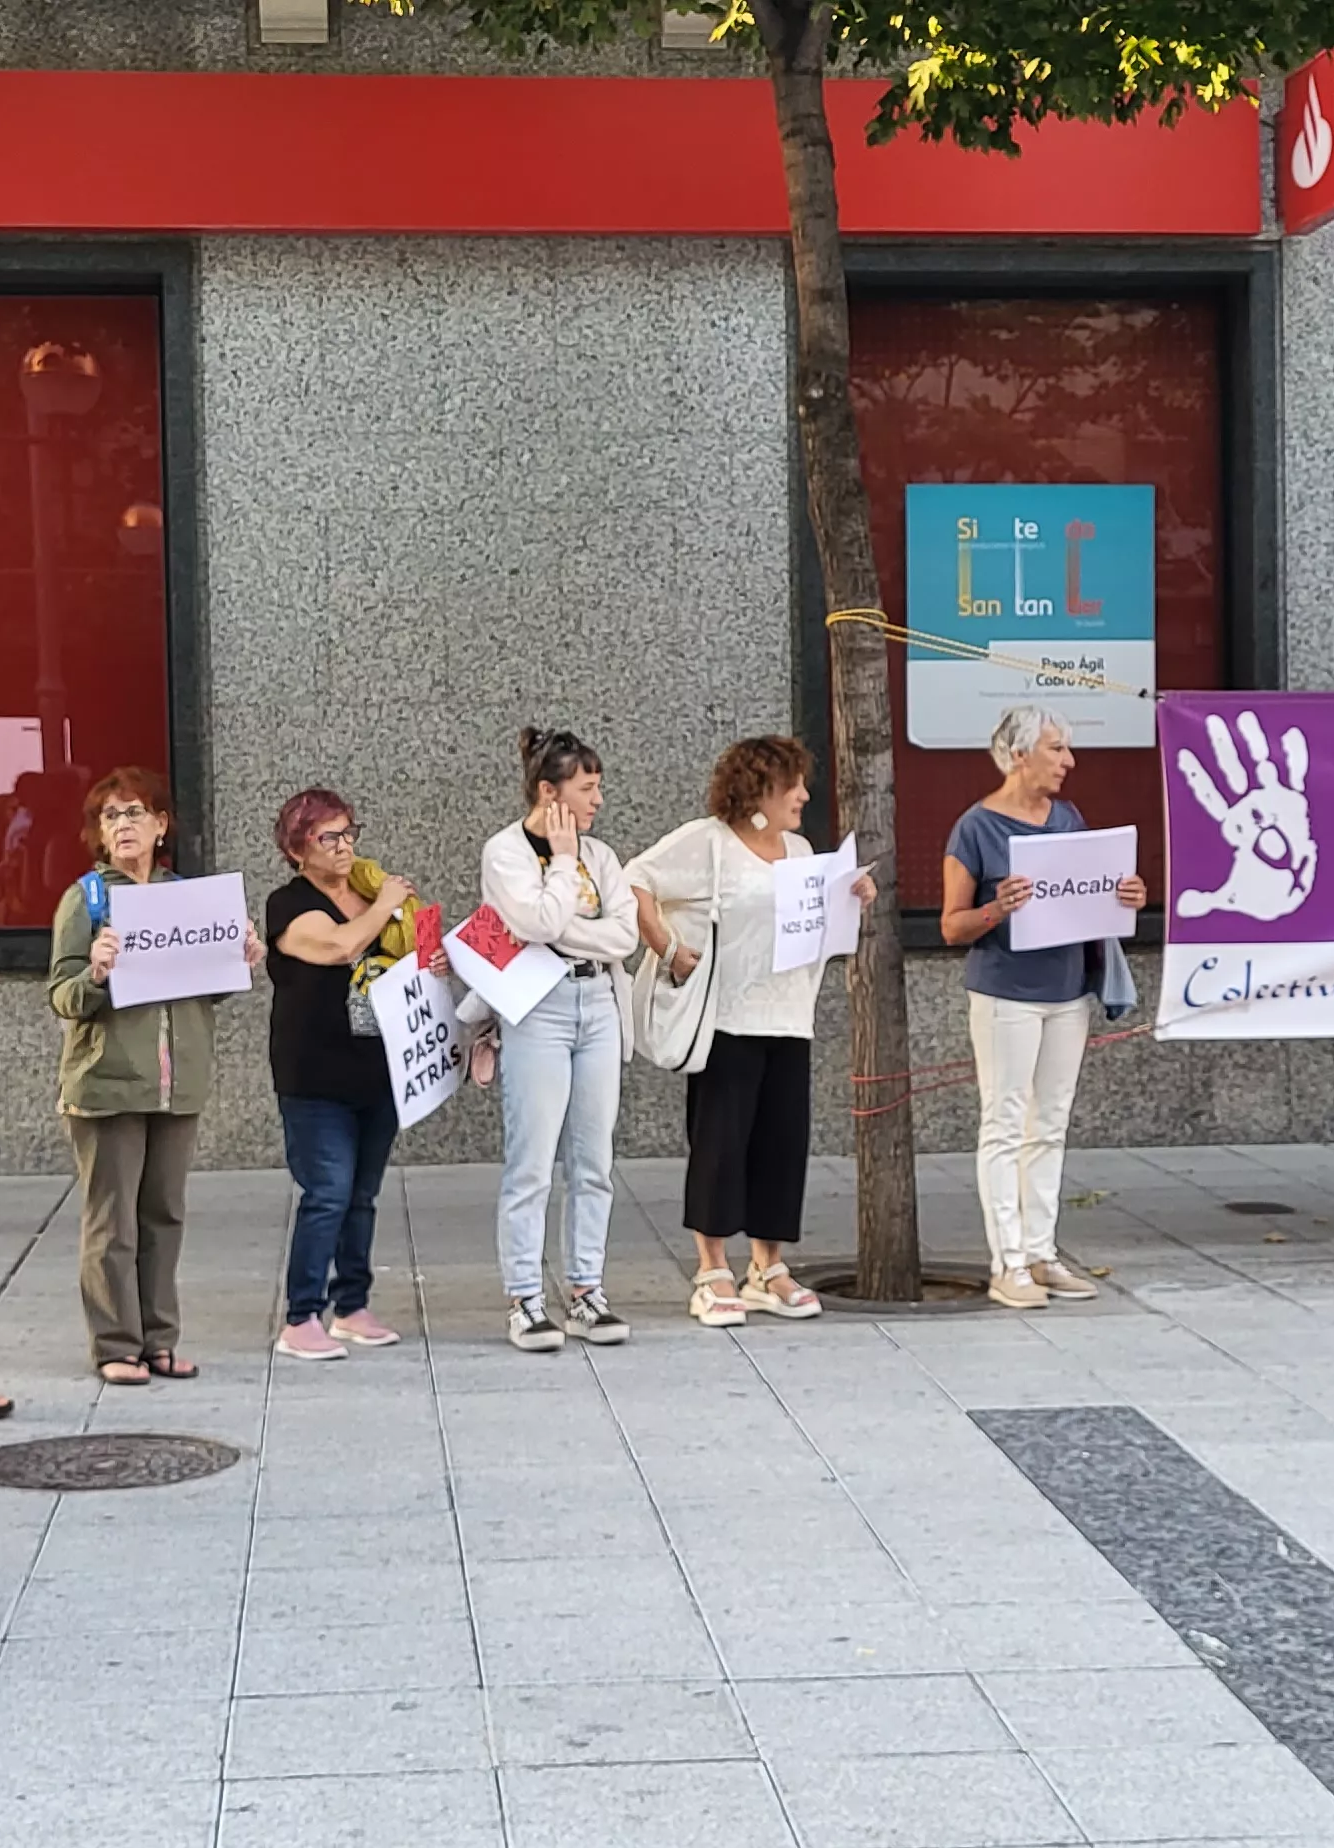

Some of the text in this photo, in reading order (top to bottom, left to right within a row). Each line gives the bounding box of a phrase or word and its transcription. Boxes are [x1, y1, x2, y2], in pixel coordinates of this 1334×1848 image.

[957, 517, 979, 540] Si
[1014, 517, 1039, 540] te
[958, 596, 1002, 617] San
[1014, 596, 1054, 617] tan
[124, 918, 240, 953] #SeAcabó
[403, 973, 424, 1005] NI
[406, 1000, 434, 1034] UN
[402, 1021, 449, 1073] PASO
[403, 1043, 462, 1105] ATRÁS
